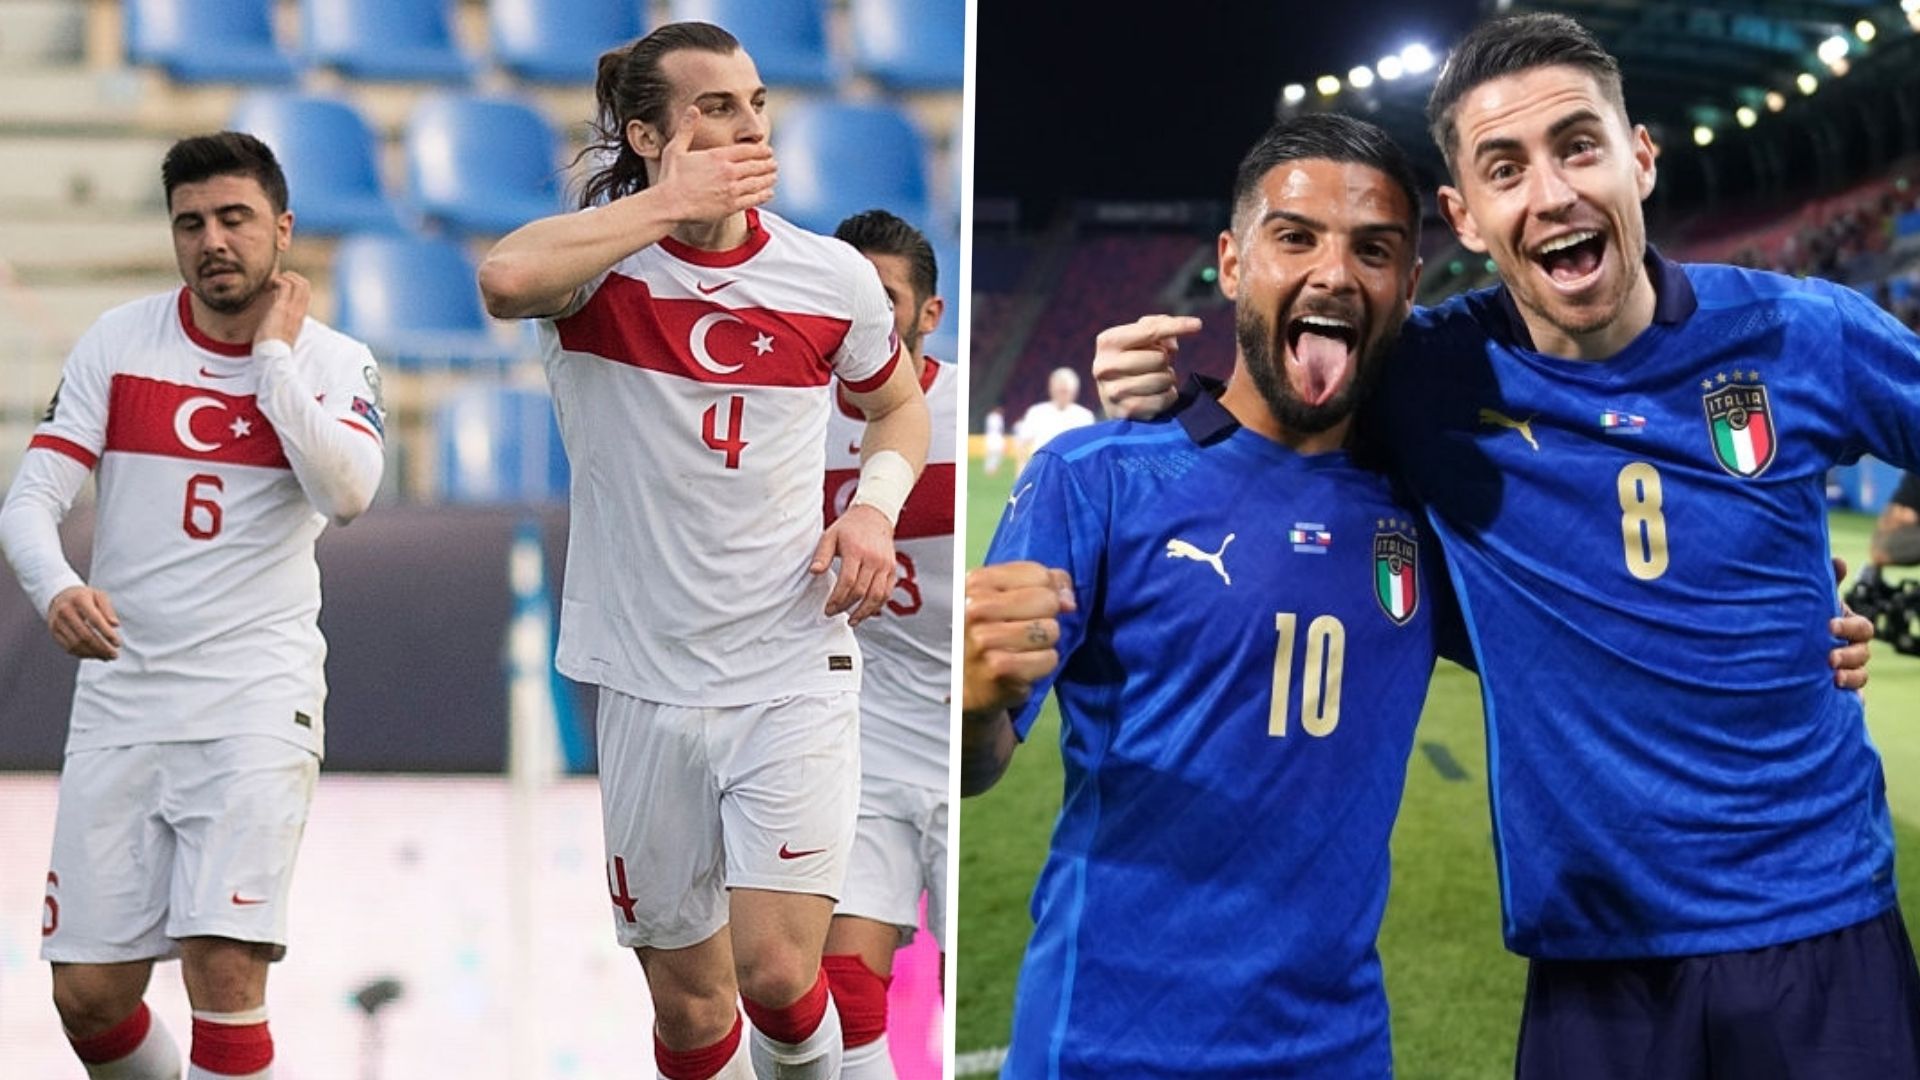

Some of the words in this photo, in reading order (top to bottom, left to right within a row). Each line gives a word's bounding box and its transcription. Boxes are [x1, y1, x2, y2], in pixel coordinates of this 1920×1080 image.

[700, 393, 748, 470] 4
[1708, 391, 1762, 413] ITALIA
[182, 473, 224, 541] 6
[1617, 462, 1669, 581] 8
[1376, 537, 1414, 558] ITALIA
[1268, 612, 1346, 738] 10
